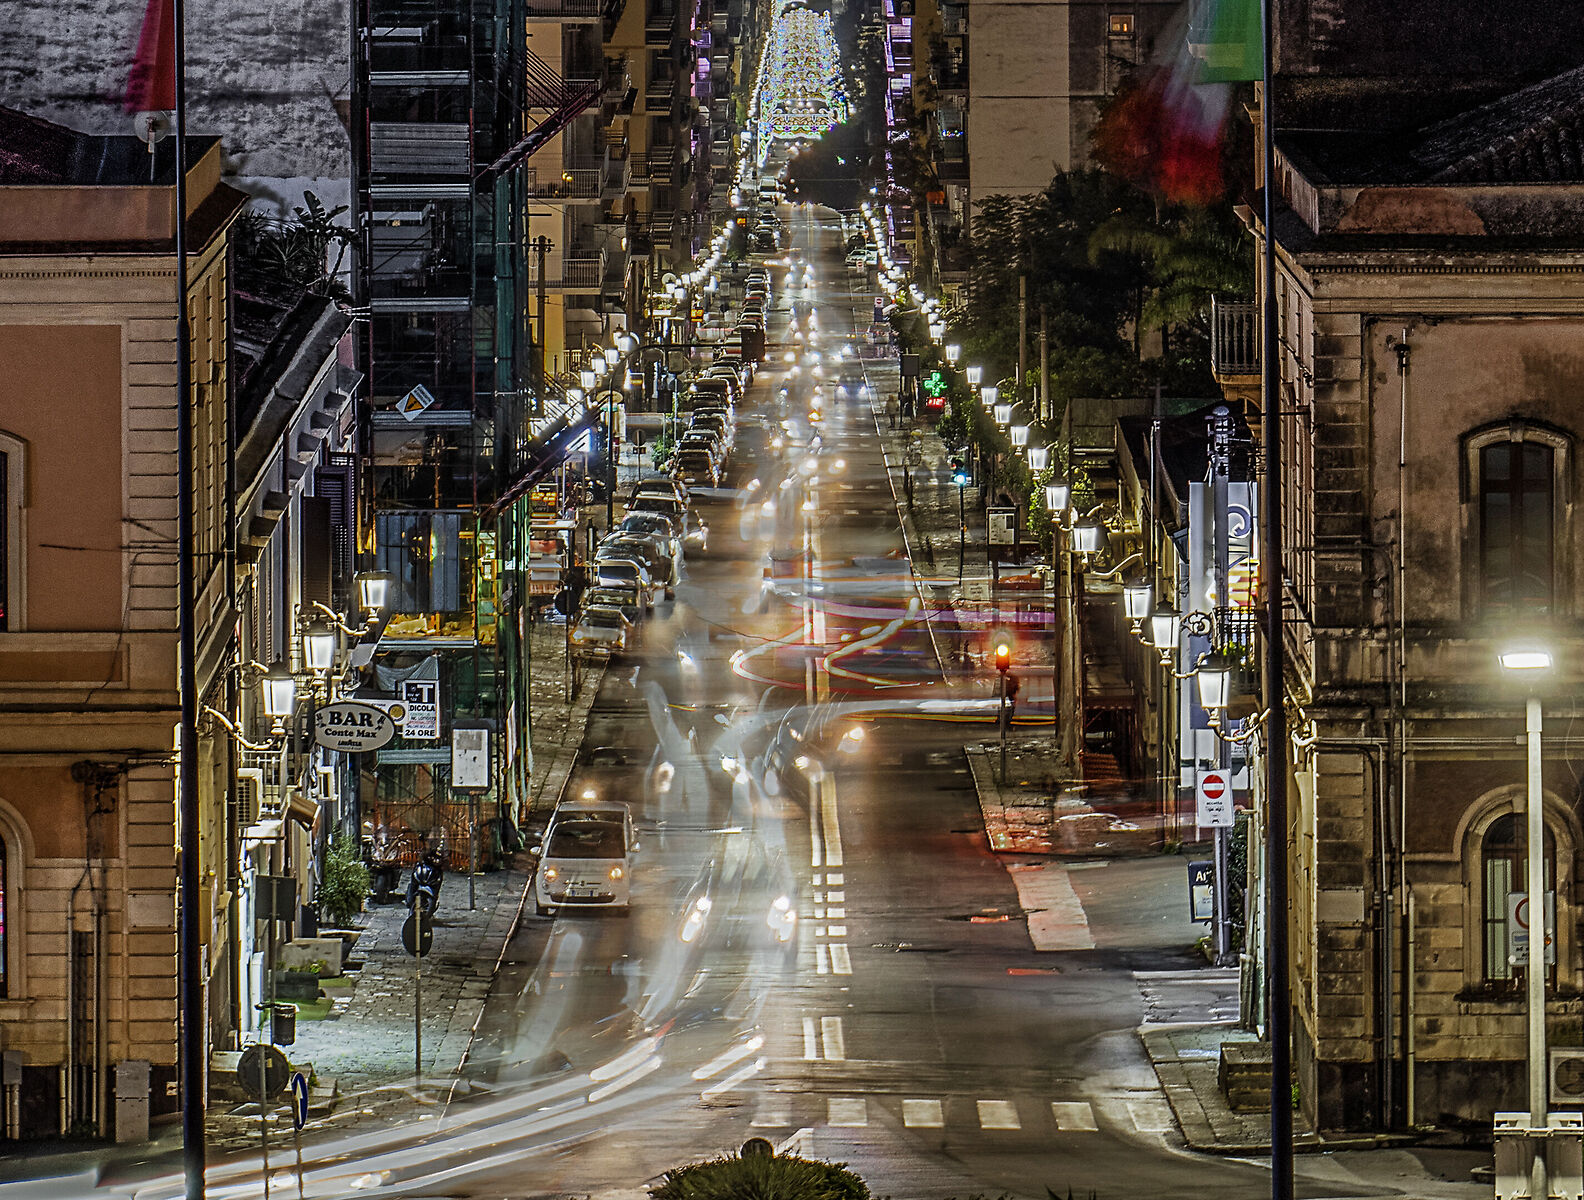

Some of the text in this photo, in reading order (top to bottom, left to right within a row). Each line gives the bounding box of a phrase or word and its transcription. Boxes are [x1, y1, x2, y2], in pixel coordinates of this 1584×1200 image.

[416, 684, 434, 702] T
[329, 711, 373, 727] BAR
[324, 728, 377, 738] Conte Max
